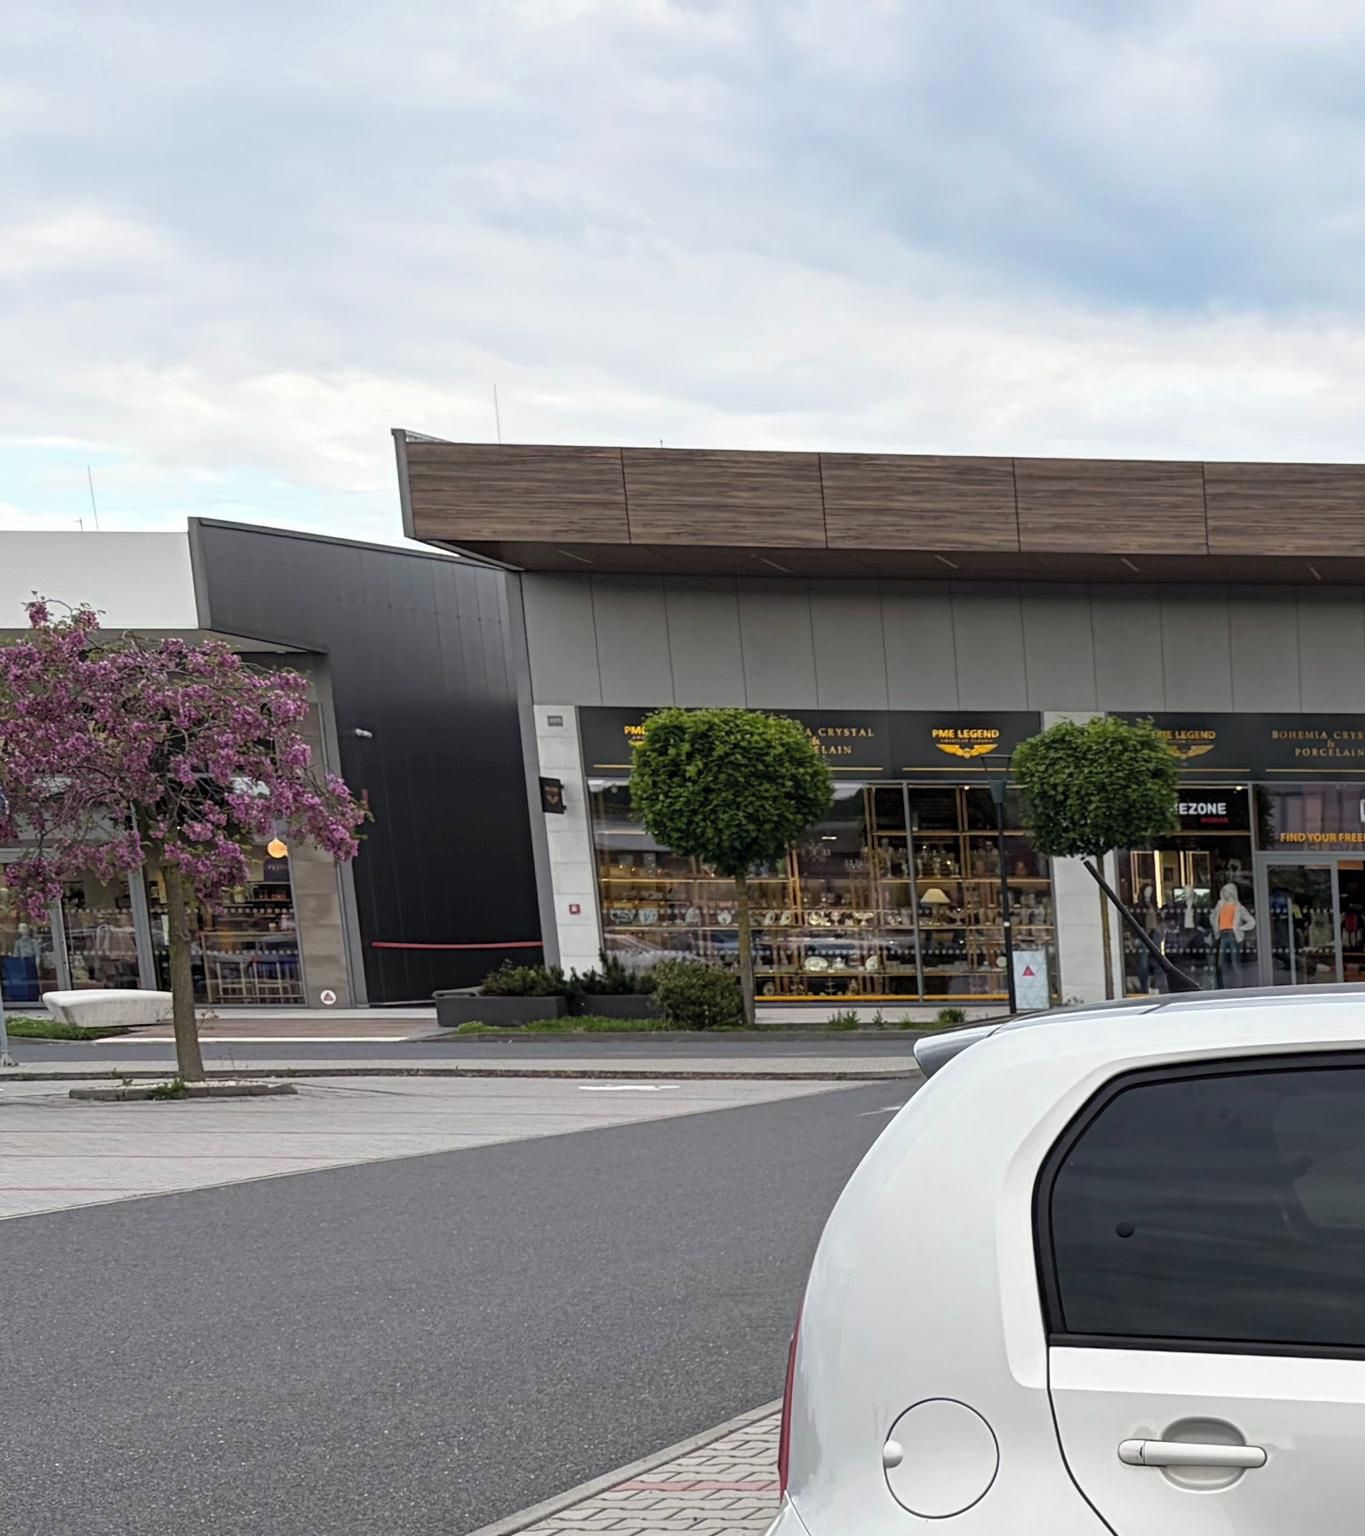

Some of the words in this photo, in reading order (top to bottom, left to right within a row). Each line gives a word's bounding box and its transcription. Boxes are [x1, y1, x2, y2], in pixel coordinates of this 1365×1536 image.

[818, 728, 874, 737] CRYSTAL
[932, 729, 955, 738] PME
[957, 729, 1000, 738] LEGEND
[1175, 730, 1217, 739] LEGEND
[1271, 730, 1328, 740] BOHEMIA
[1295, 747, 1365, 757] PORCELAIN
[1280, 832, 1306, 843] FIND
[1306, 832, 1338, 843] YOUR
